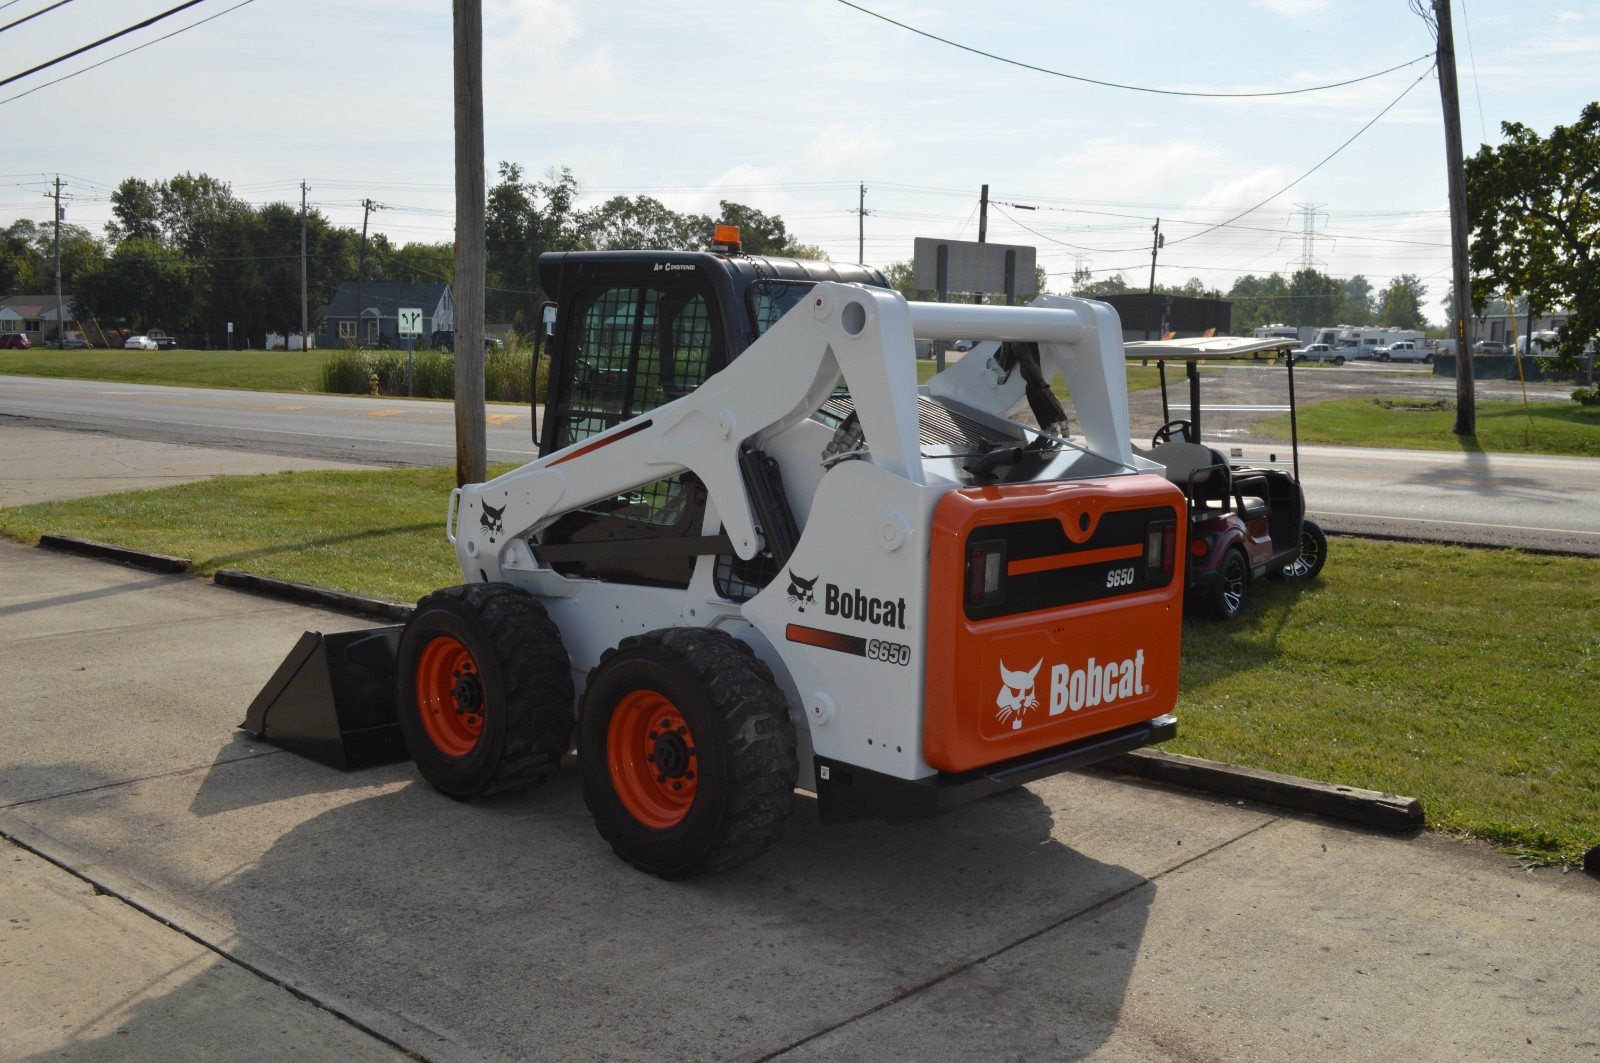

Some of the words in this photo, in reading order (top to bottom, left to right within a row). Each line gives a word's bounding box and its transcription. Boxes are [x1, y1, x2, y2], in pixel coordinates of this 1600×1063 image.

[1106, 567, 1135, 588] S650
[825, 583, 906, 630] Bobcat
[868, 638, 911, 666] S650
[1049, 649, 1145, 717] Bobcat
